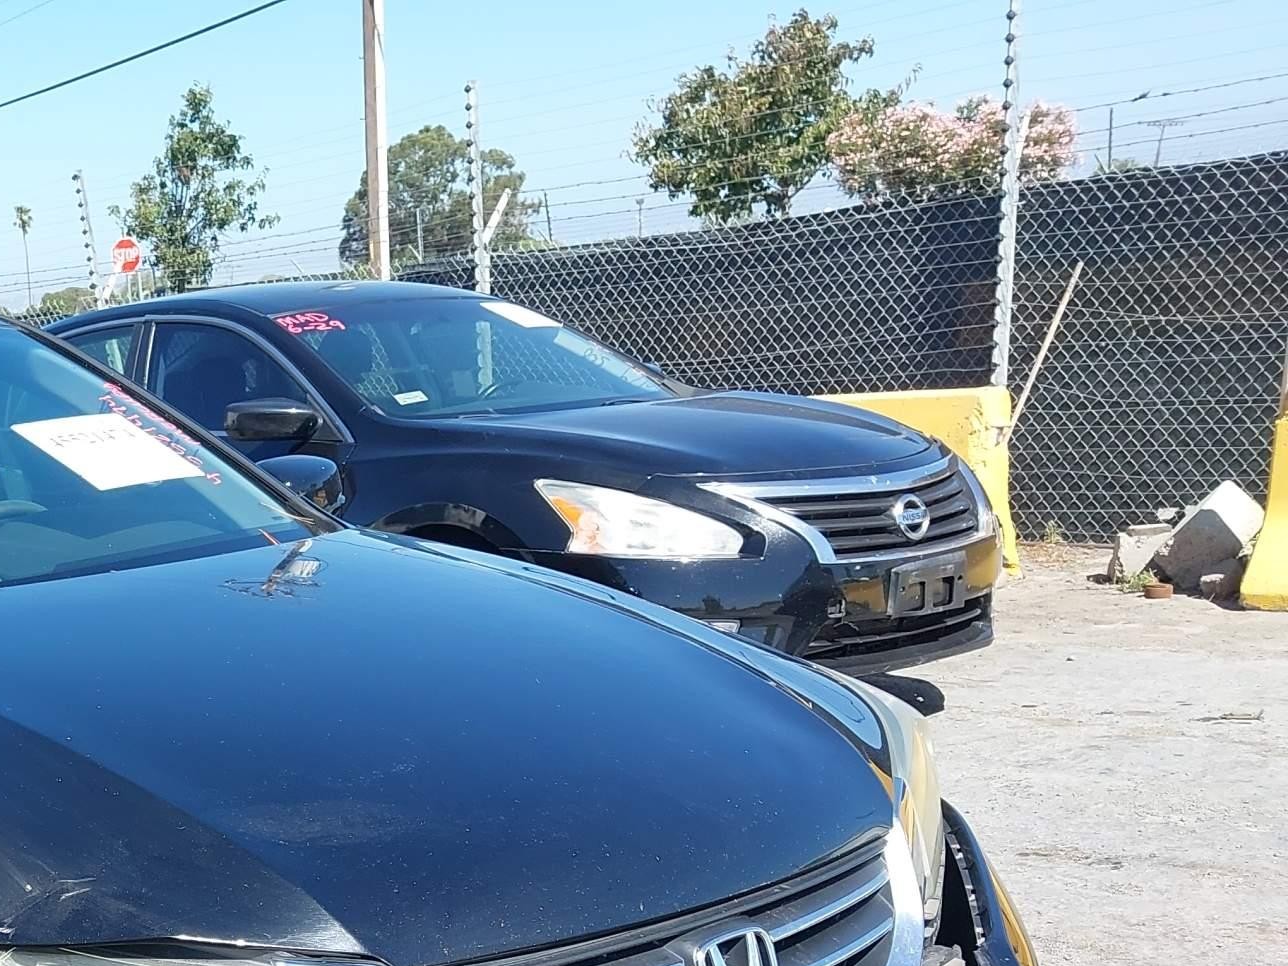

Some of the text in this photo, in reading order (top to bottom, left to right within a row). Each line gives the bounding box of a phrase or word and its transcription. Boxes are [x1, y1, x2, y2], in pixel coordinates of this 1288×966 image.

[114, 248, 139, 261] STOP
[276, 312, 329, 327] MAD
[288, 320, 346, 334] 6-29
